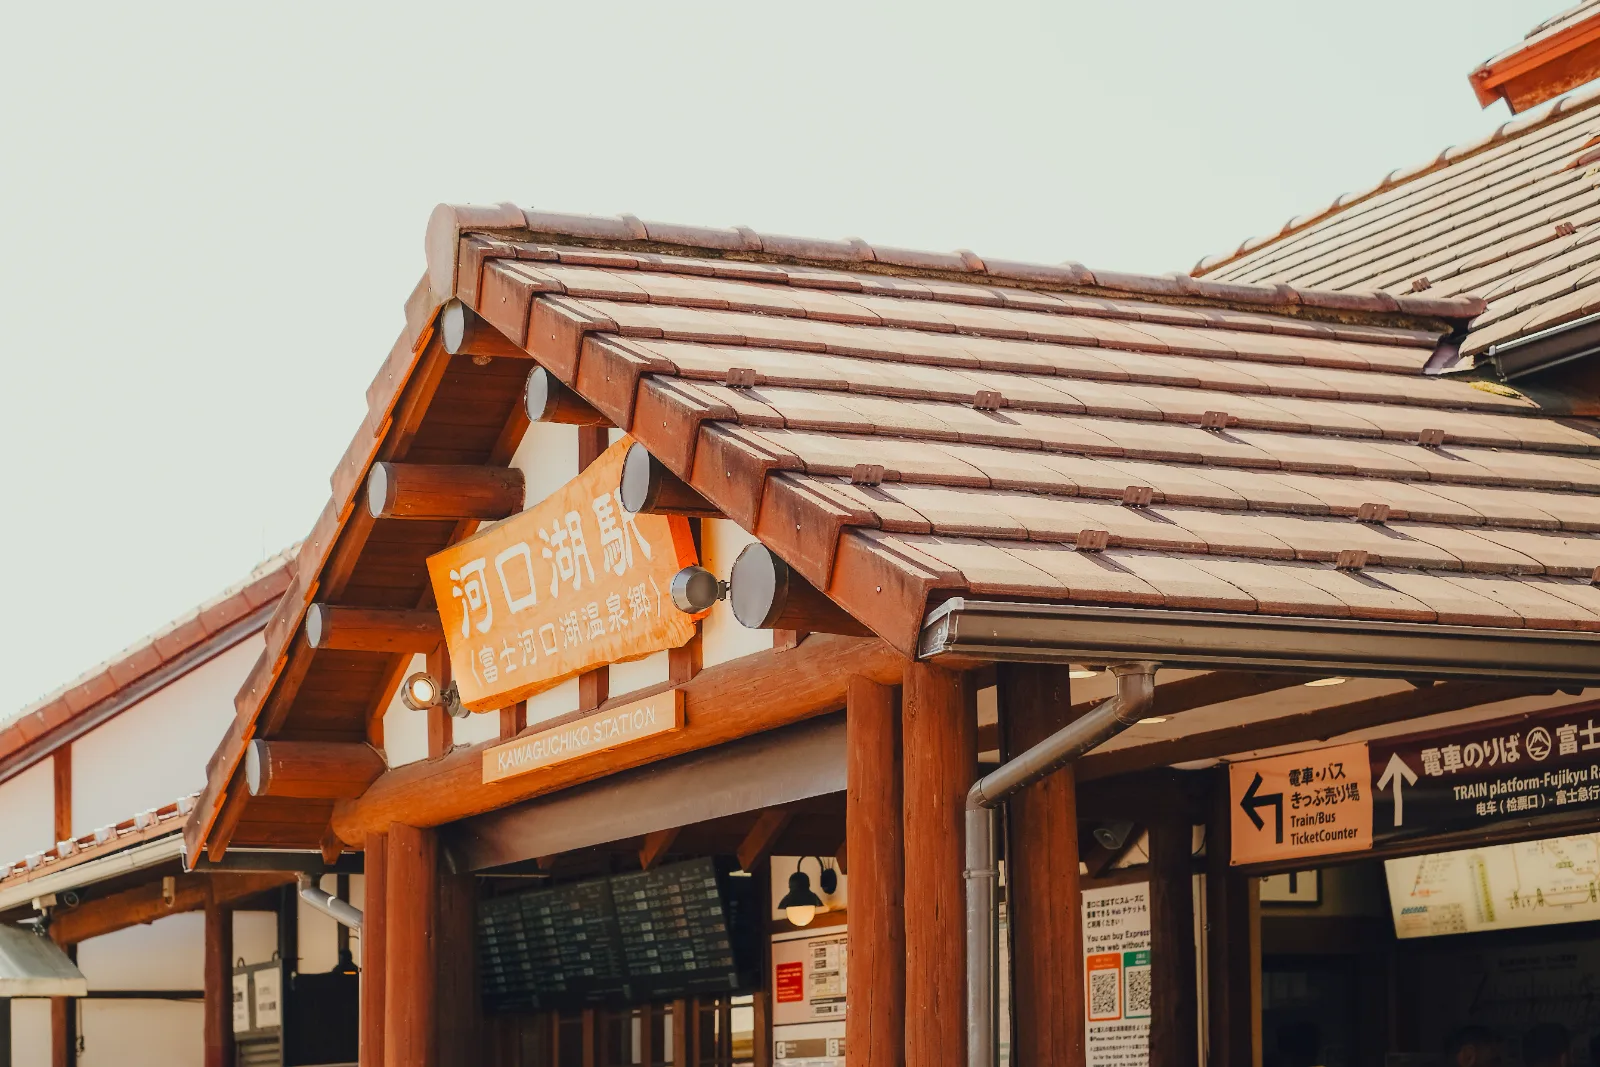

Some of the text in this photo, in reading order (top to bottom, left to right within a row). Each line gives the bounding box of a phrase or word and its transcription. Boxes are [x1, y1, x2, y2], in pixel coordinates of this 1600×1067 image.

[497, 704, 657, 773] KAWAGUCHIKO STATION
[1420, 718, 1600, 777] 電車のりば 富士
[1288, 762, 1346, 787] 電車・バス
[1453, 782, 1488, 801] TRAIN
[1290, 811, 1336, 828] Train/Bus
[1086, 934, 1099, 943] You
[1100, 933, 1111, 941] can
[1112, 932, 1124, 940] buy
[1095, 944, 1105, 952] the
[1107, 943, 1120, 951] web
[1122, 940, 1145, 950] without
